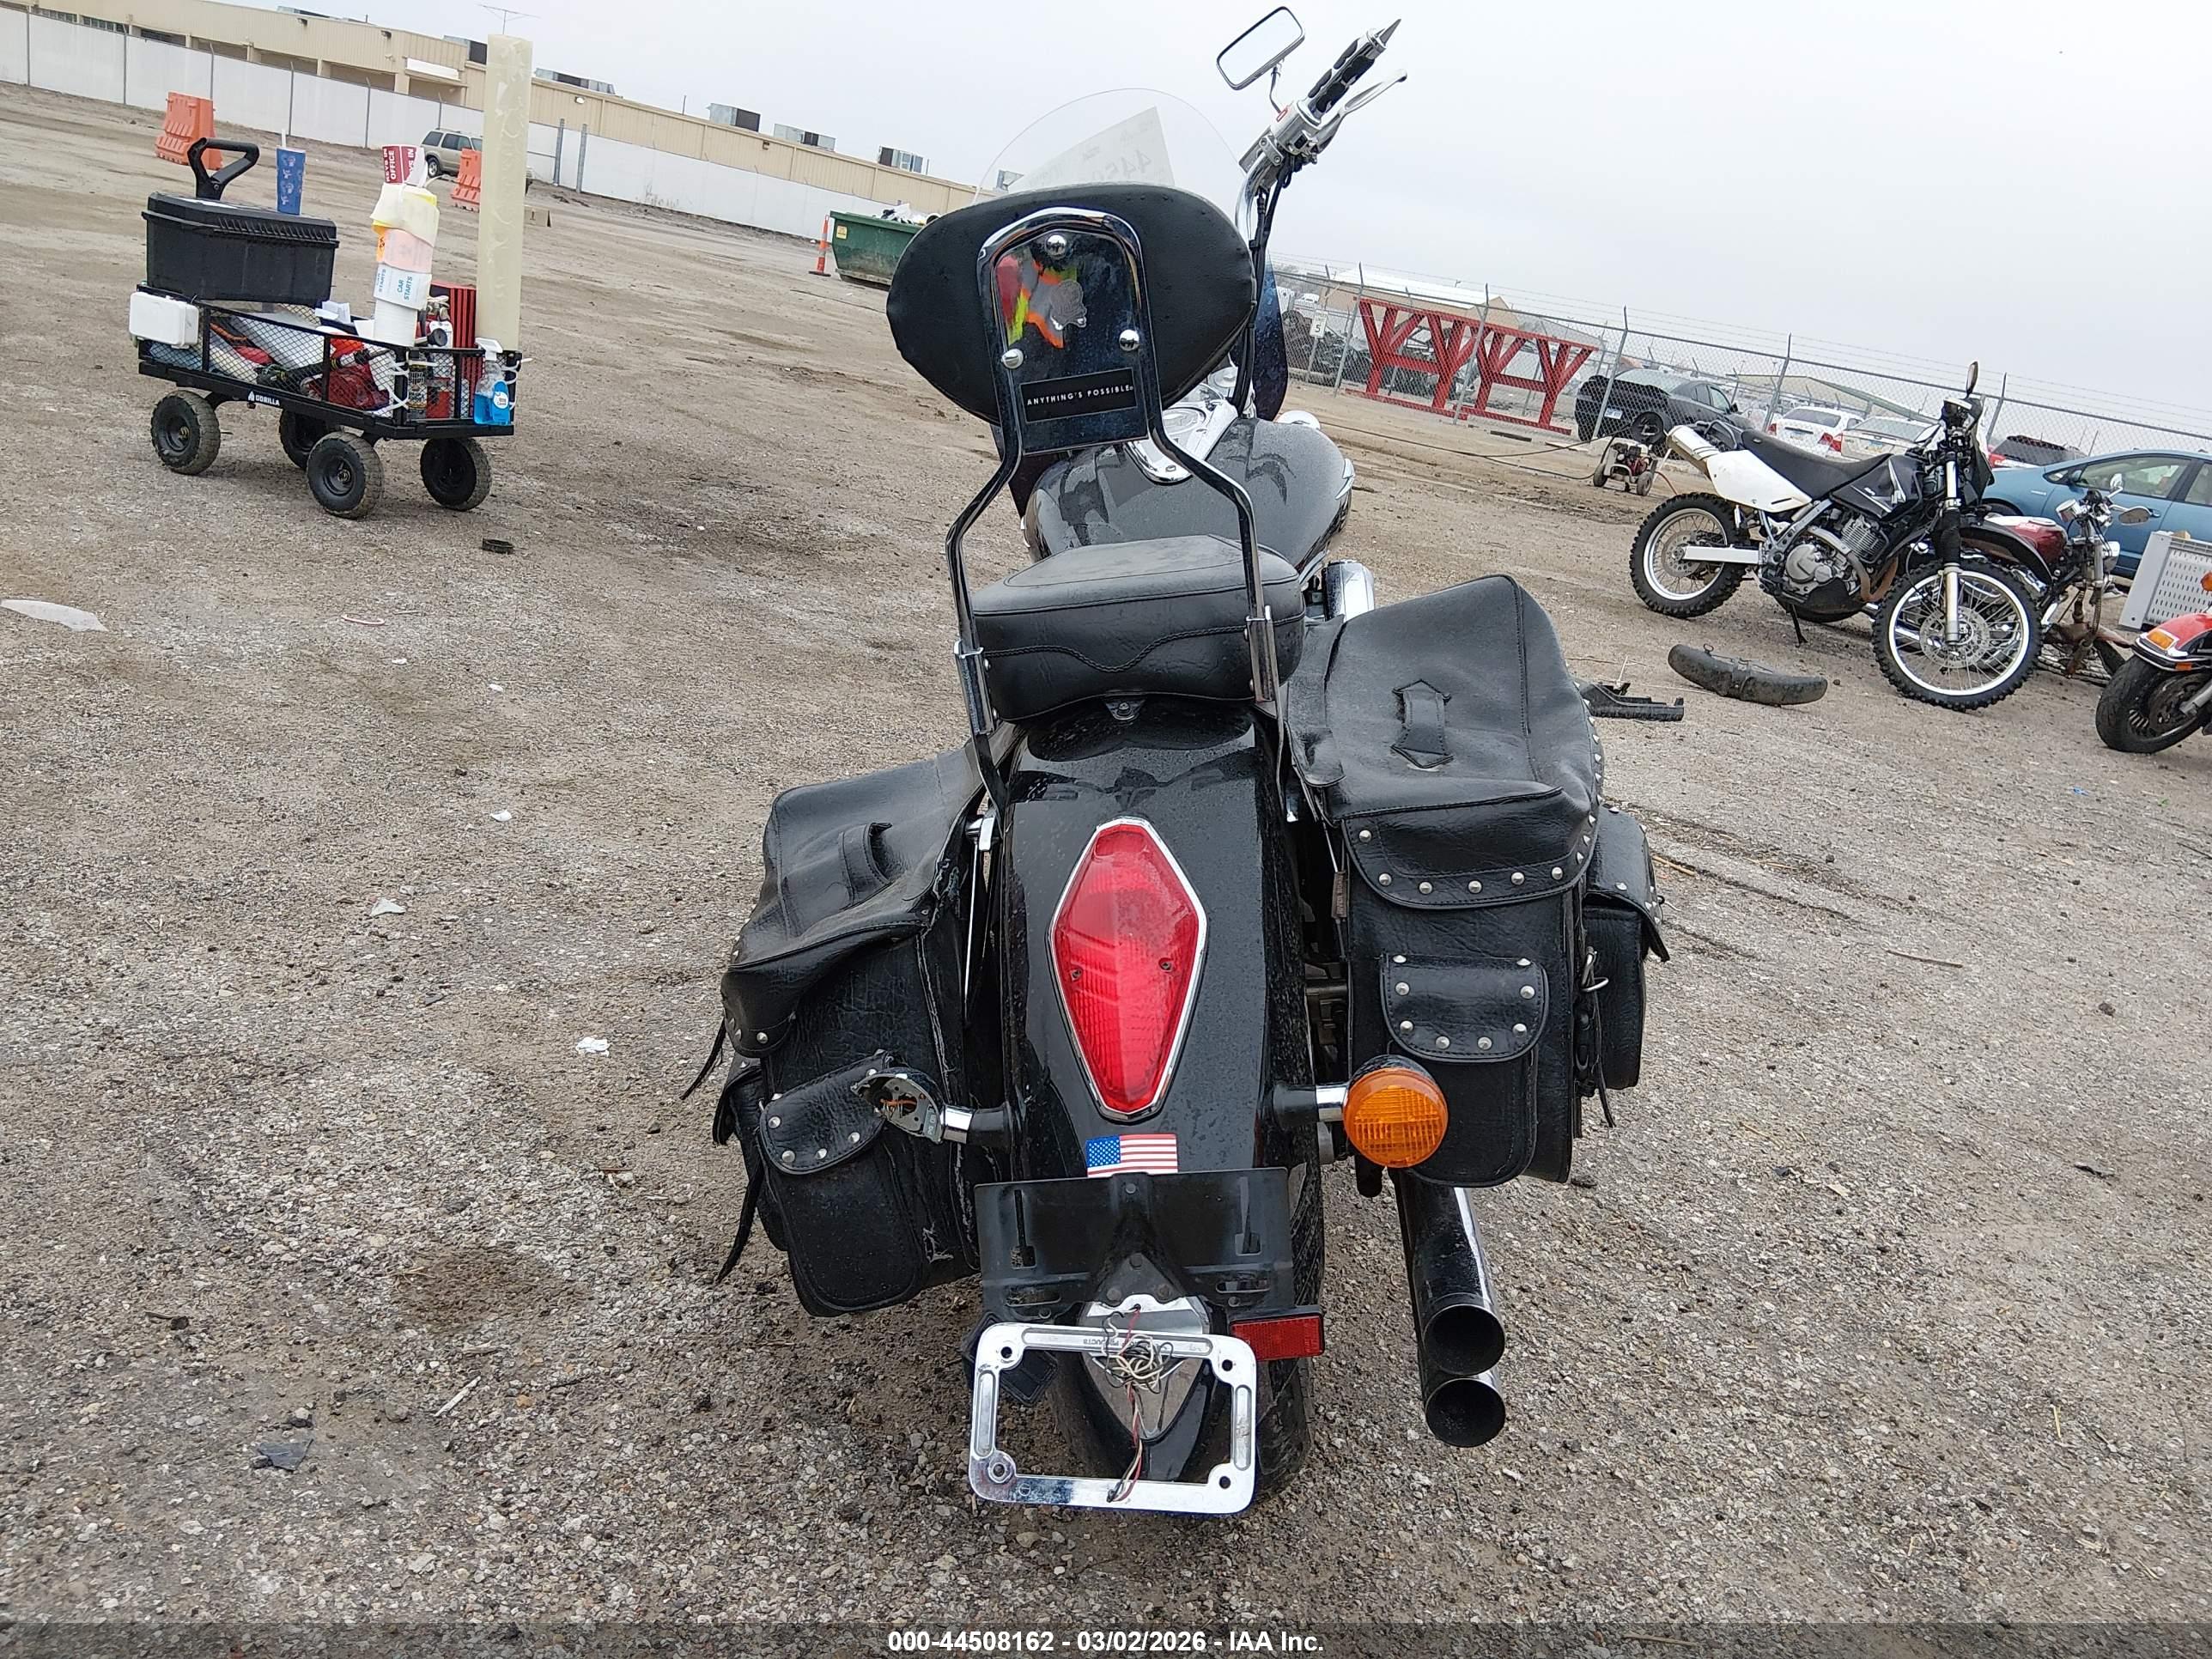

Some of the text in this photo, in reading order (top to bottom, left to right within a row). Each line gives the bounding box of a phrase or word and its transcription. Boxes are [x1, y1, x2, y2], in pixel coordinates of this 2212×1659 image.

[407, 149, 414, 158] IN
[388, 149, 397, 180] OFFICE
[404, 276, 413, 301] STARTS
[1315, 324, 1322, 333] 5
[255, 394, 281, 406] GORILLA
[1027, 392, 1083, 405] ANYTHING'S
